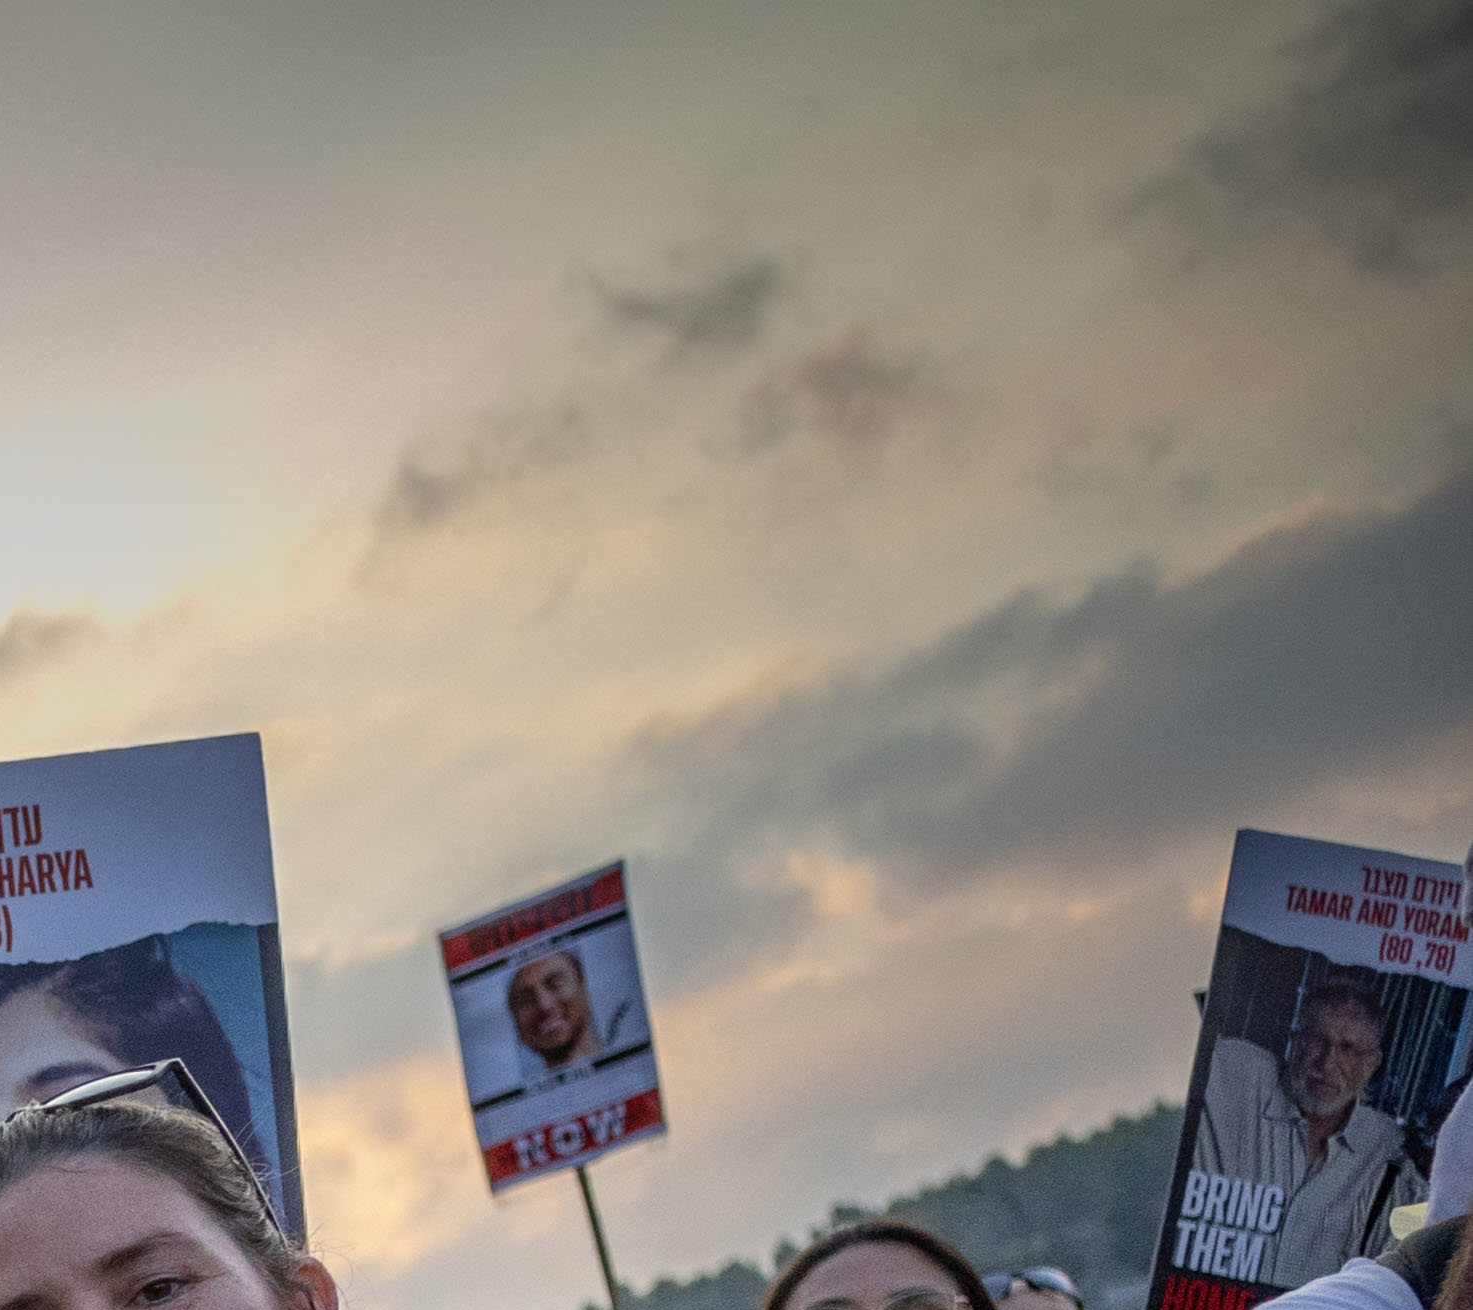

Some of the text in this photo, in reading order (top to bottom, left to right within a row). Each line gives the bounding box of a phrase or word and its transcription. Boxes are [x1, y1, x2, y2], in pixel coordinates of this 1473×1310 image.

[1285, 883, 1398, 929] TAMAR AND
[514, 1102, 628, 1171] NOW
[1181, 1169, 1285, 1234] BRING
[1173, 1218, 1264, 1283] THEM
